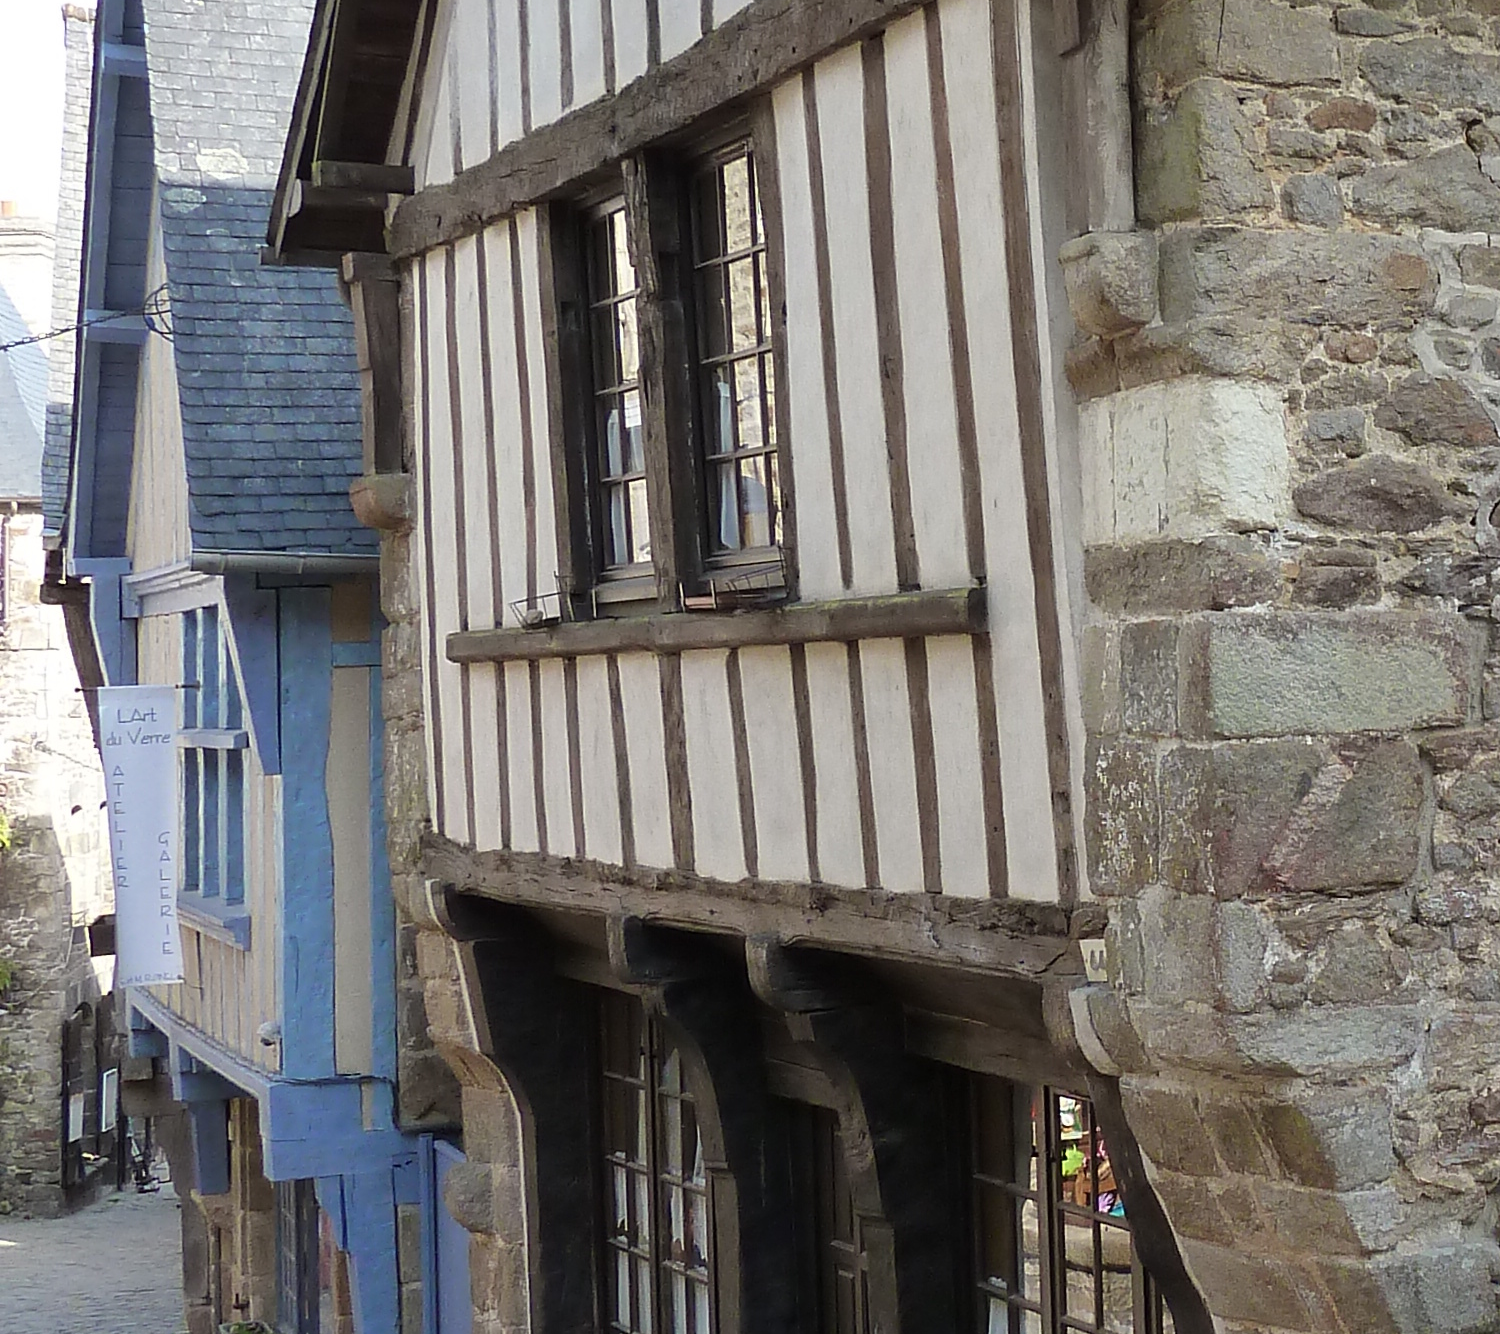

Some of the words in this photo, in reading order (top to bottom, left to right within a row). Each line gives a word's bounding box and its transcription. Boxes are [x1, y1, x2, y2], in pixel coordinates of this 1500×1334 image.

[106, 731, 122, 746] du
[127, 727, 171, 745] Verre
[112, 765, 129, 888] ATELIER
[158, 831, 175, 955] GALERIE
